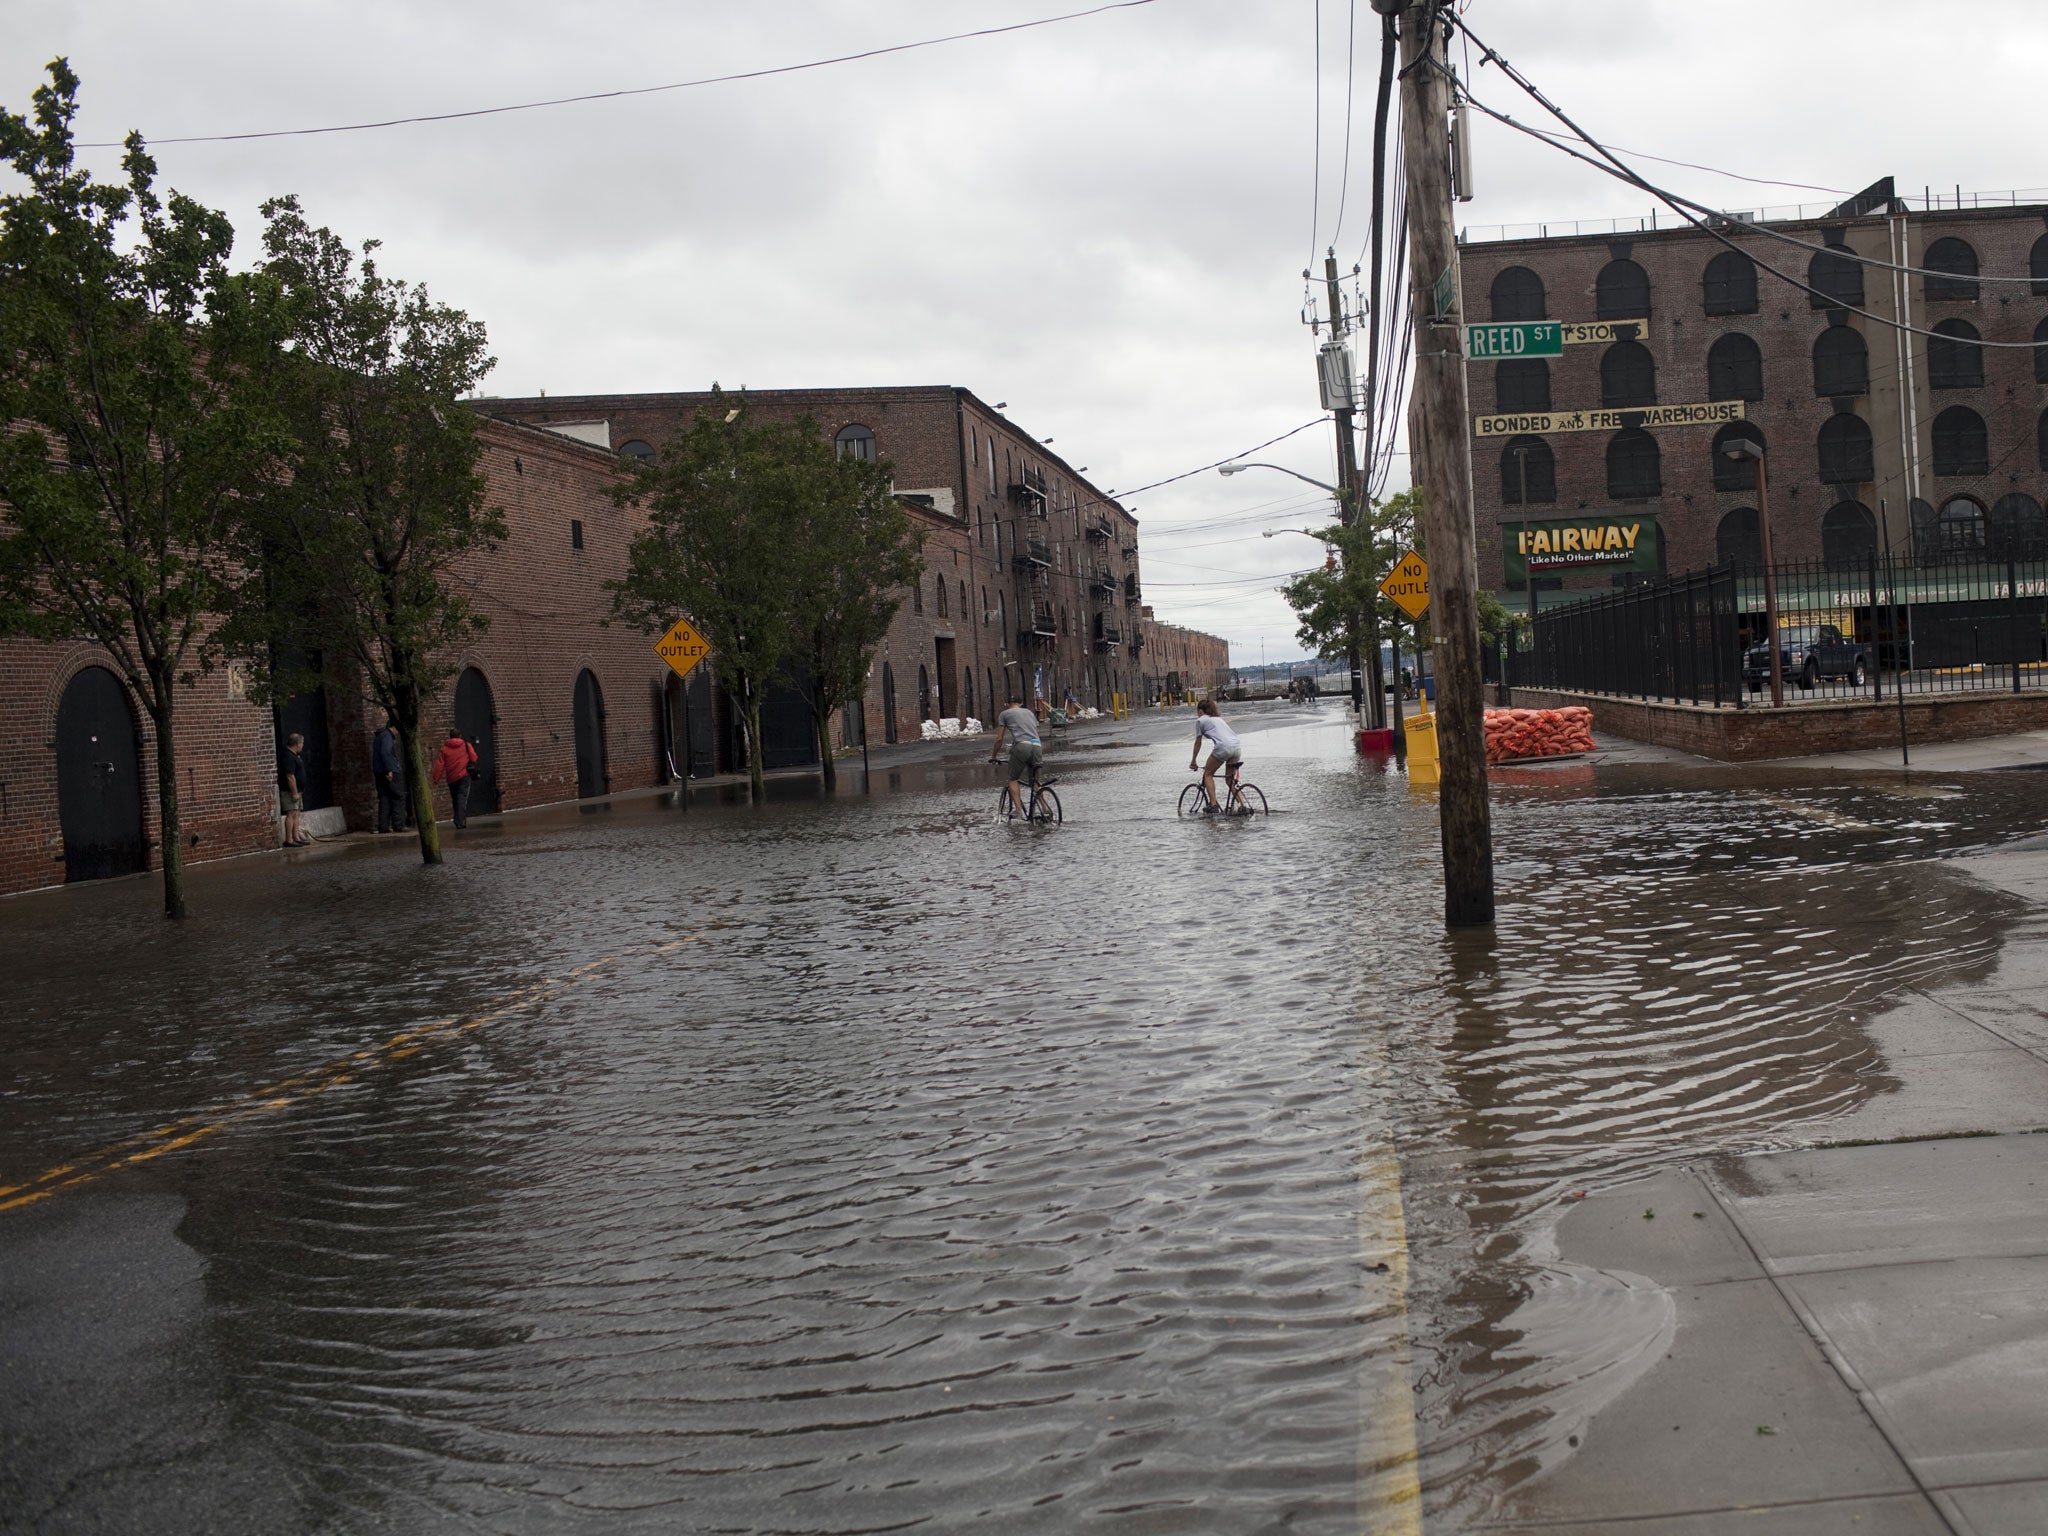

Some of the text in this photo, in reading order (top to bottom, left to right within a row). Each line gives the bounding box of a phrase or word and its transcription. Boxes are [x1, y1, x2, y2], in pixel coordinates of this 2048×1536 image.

[1576, 322, 1642, 340] STOS
[1473, 326, 1553, 356] REED ST
[1482, 416, 1551, 433] BONDED
[1558, 418, 1585, 430] AND
[1590, 412, 1622, 428] FRE
[1518, 523, 1640, 555] FAIRWAY
[1551, 555, 1565, 563] No
[1566, 553, 1593, 562] Other
[1403, 565, 1422, 577] NO
[1388, 582, 1429, 596] OUTLE
[674, 631, 690, 641] NO
[661, 646, 704, 656] OUTLET
